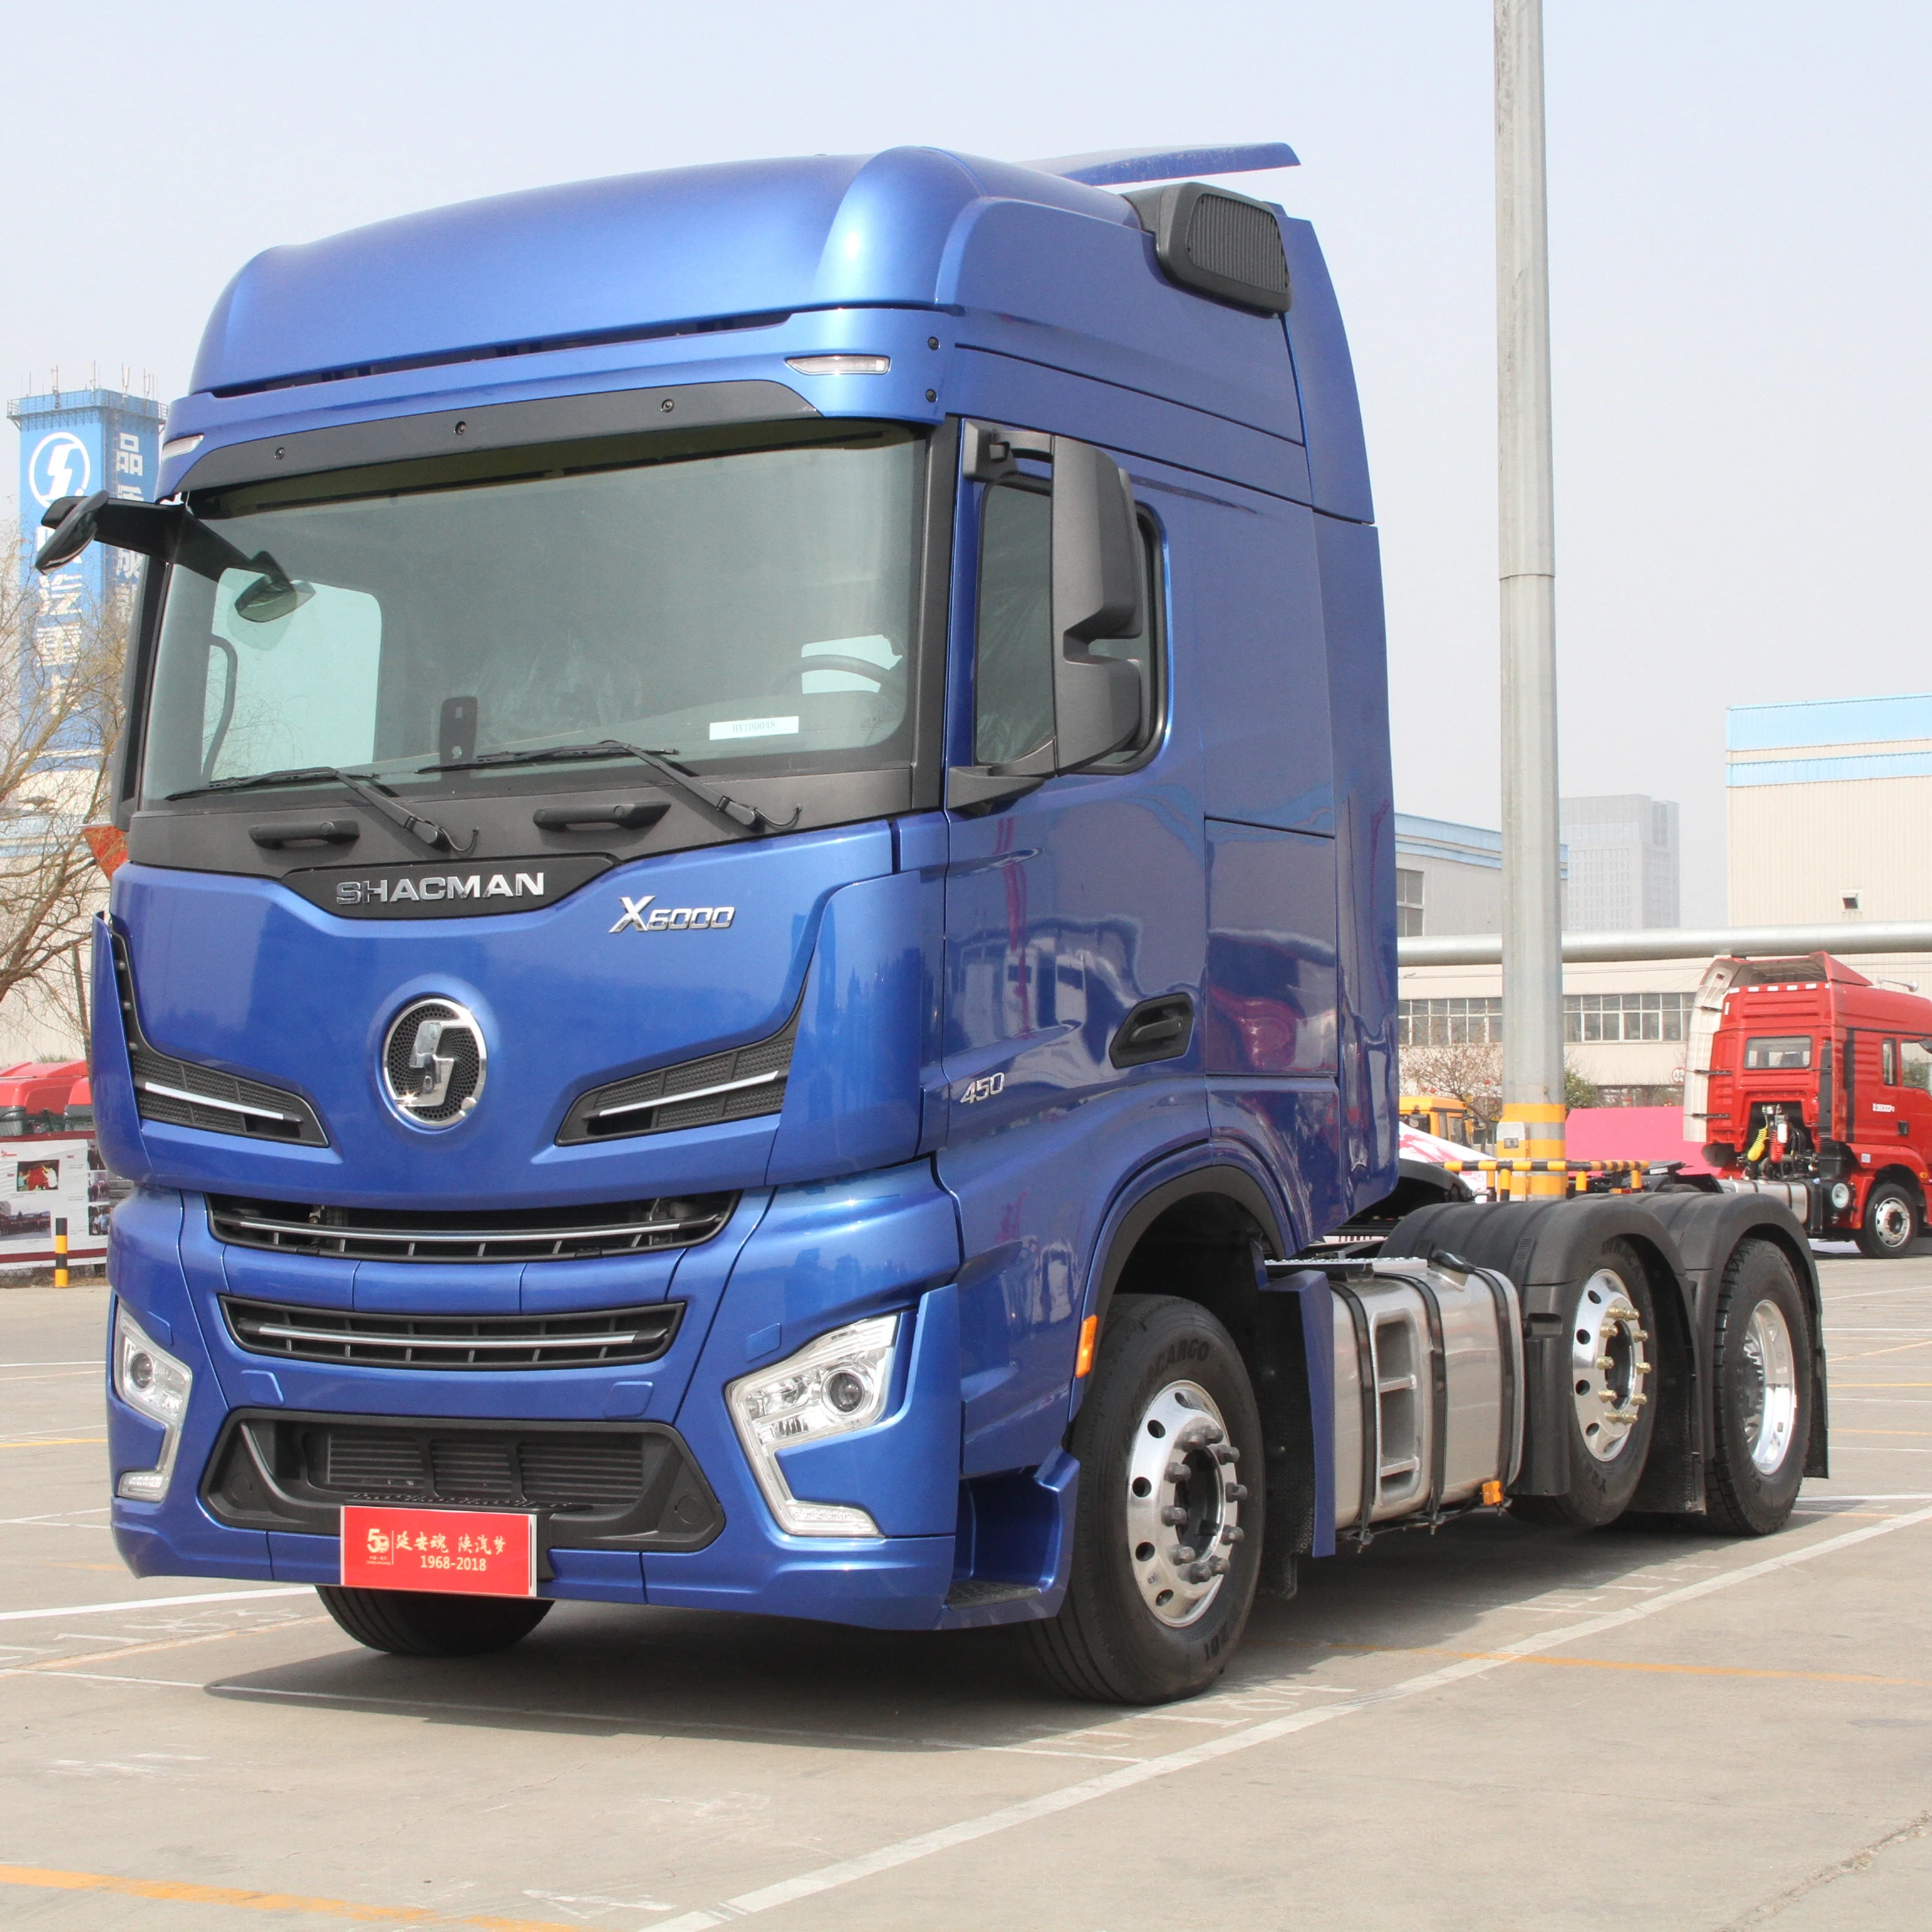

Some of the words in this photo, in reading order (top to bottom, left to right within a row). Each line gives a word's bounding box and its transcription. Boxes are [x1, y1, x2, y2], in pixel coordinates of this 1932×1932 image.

[336, 872, 544, 905] SHACMAN
[608, 896, 735, 932] X6000
[960, 1072, 1005, 1104] 450
[396, 1530, 449, 1554] 延安魂
[458, 1533, 506, 1555] 陕汽梦
[420, 1555, 486, 1571] 1968-2018
